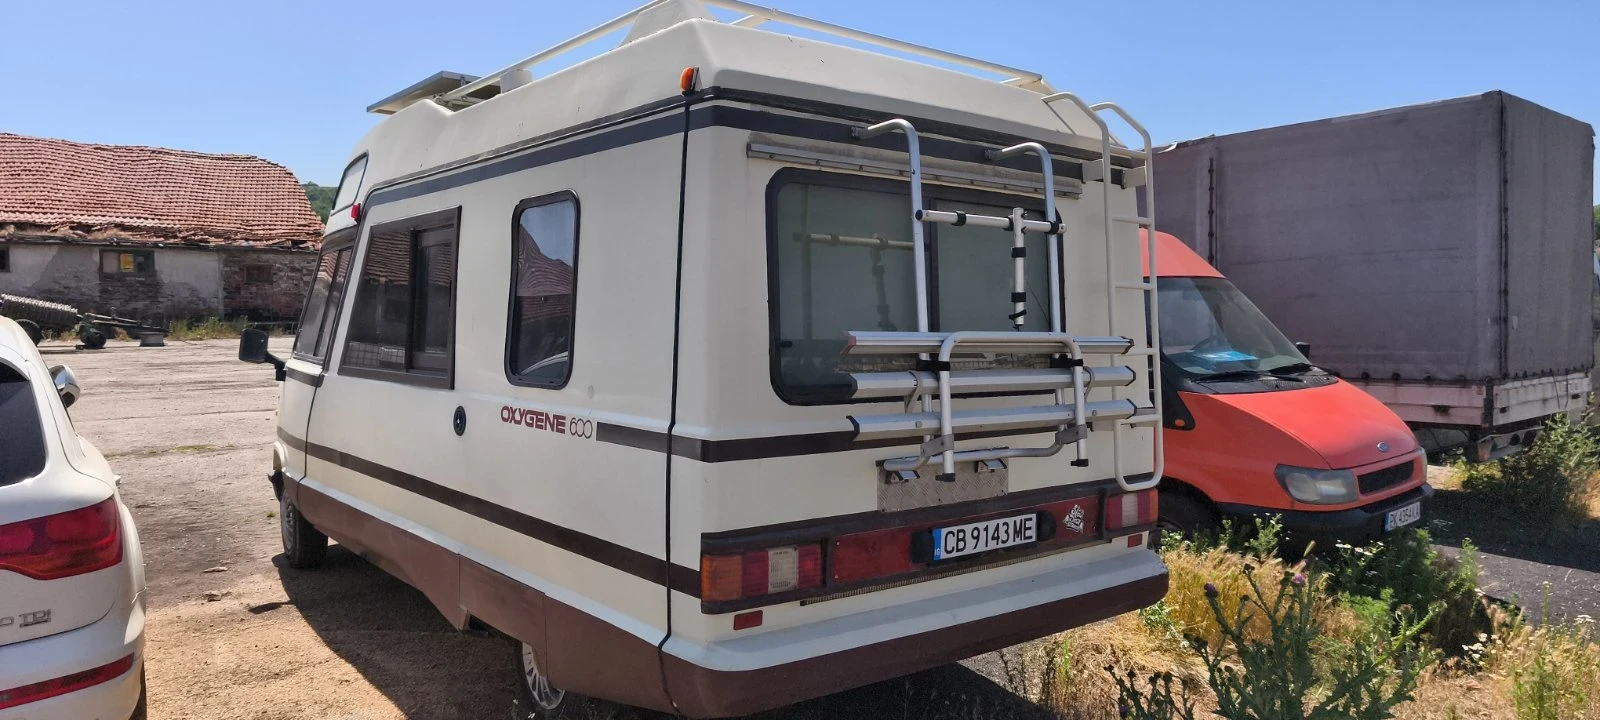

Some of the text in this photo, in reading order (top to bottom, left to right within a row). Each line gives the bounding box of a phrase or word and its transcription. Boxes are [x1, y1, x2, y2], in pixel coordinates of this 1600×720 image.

[501, 406, 593, 439] OXYGENE 600
[944, 529, 966, 554] CB
[971, 521, 1010, 550] 9143
[1013, 517, 1033, 543] ME
[19, 609, 51, 628] TDI
